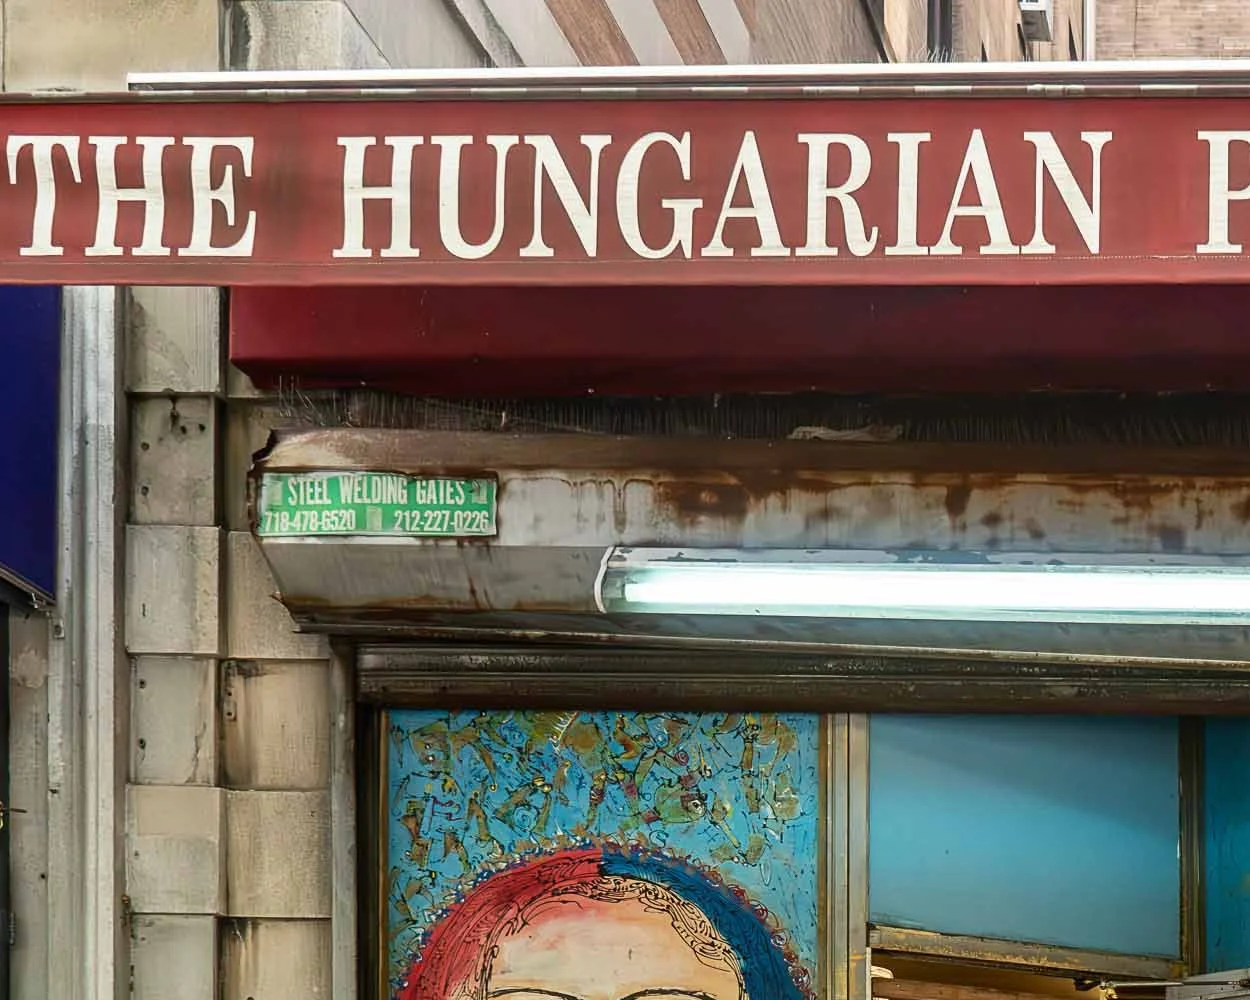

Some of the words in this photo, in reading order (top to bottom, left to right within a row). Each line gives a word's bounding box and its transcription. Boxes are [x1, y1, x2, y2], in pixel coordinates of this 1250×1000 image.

[7, 136, 256, 257] THE
[333, 129, 1112, 260] HUNGARIAN
[287, 479, 331, 505] STEEL
[338, 475, 407, 504] WELDING
[416, 480, 465, 505] GATES
[264, 511, 355, 532] 718-478-6520
[394, 510, 489, 532] 212-227-0226
